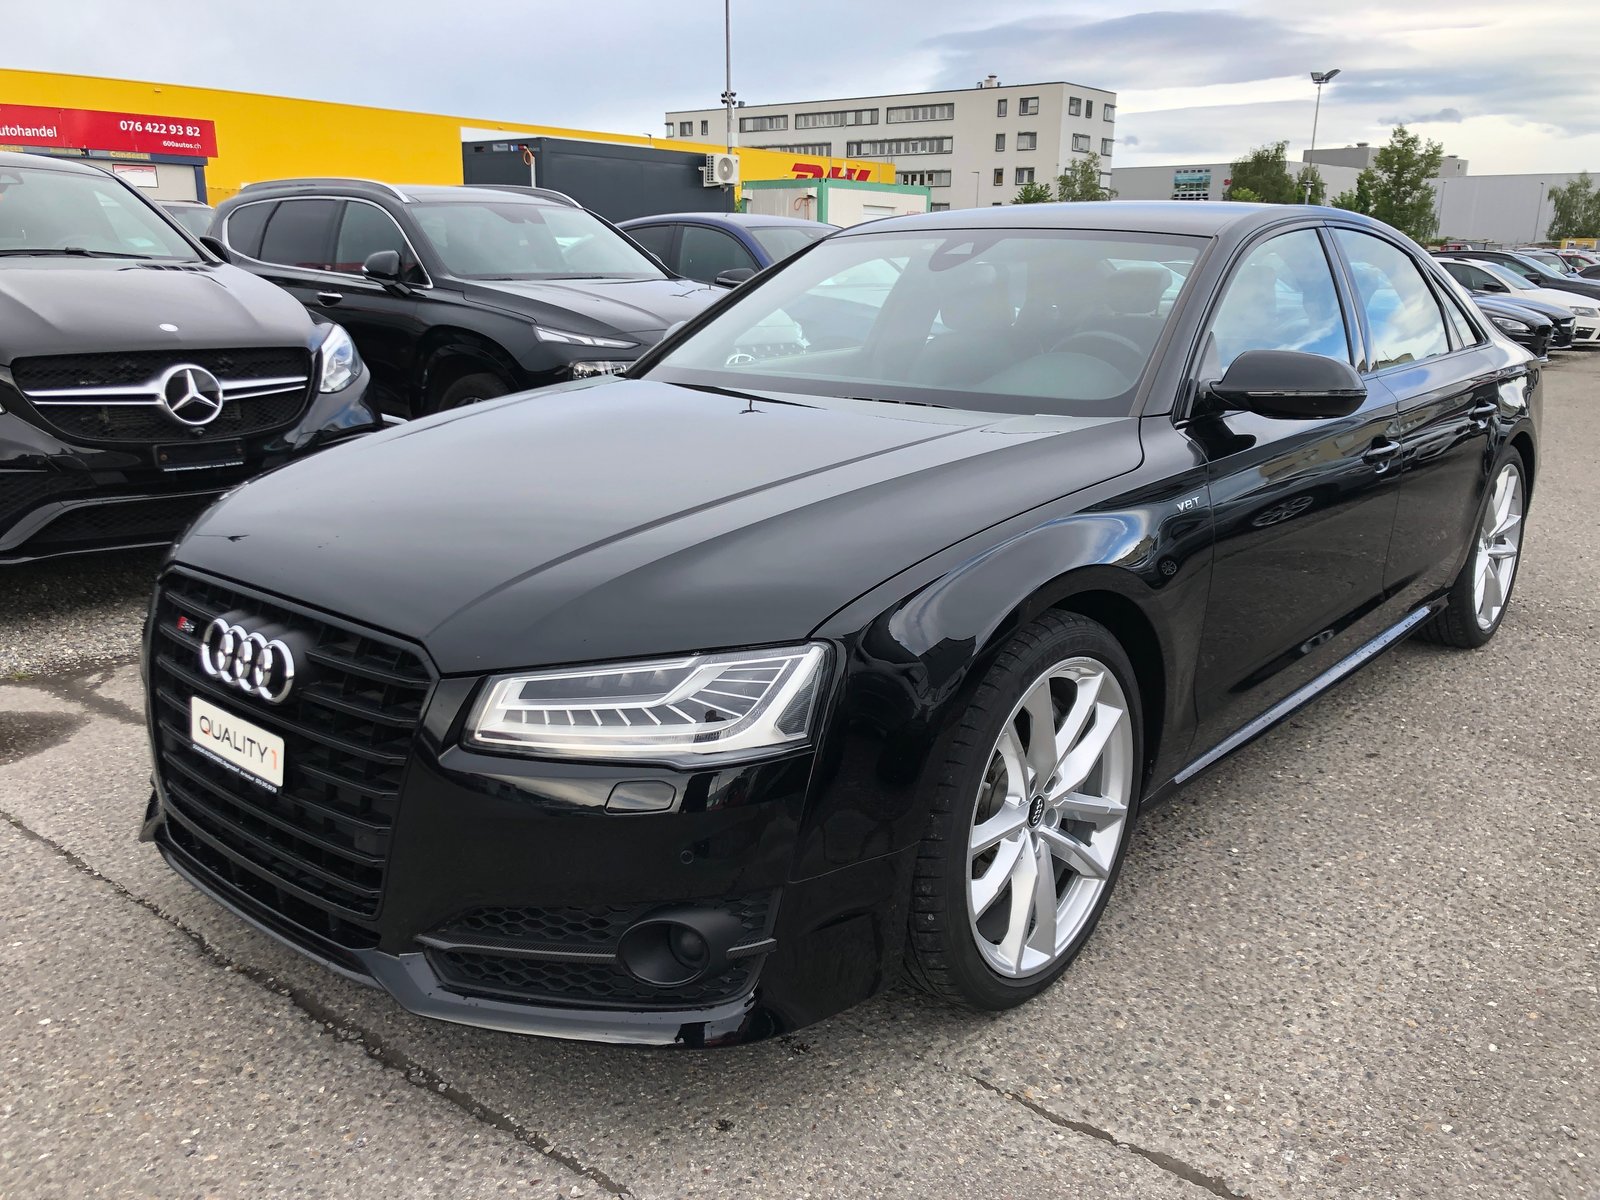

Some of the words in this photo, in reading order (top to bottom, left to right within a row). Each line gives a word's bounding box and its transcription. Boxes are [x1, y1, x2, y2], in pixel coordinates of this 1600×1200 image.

[120, 120, 143, 131] 076
[145, 122, 167, 133] 422
[169, 124, 184, 135] 93
[186, 126, 200, 136] 82
[162, 140, 202, 149] 600autos.ch
[1177, 496, 1200, 511] V8T
